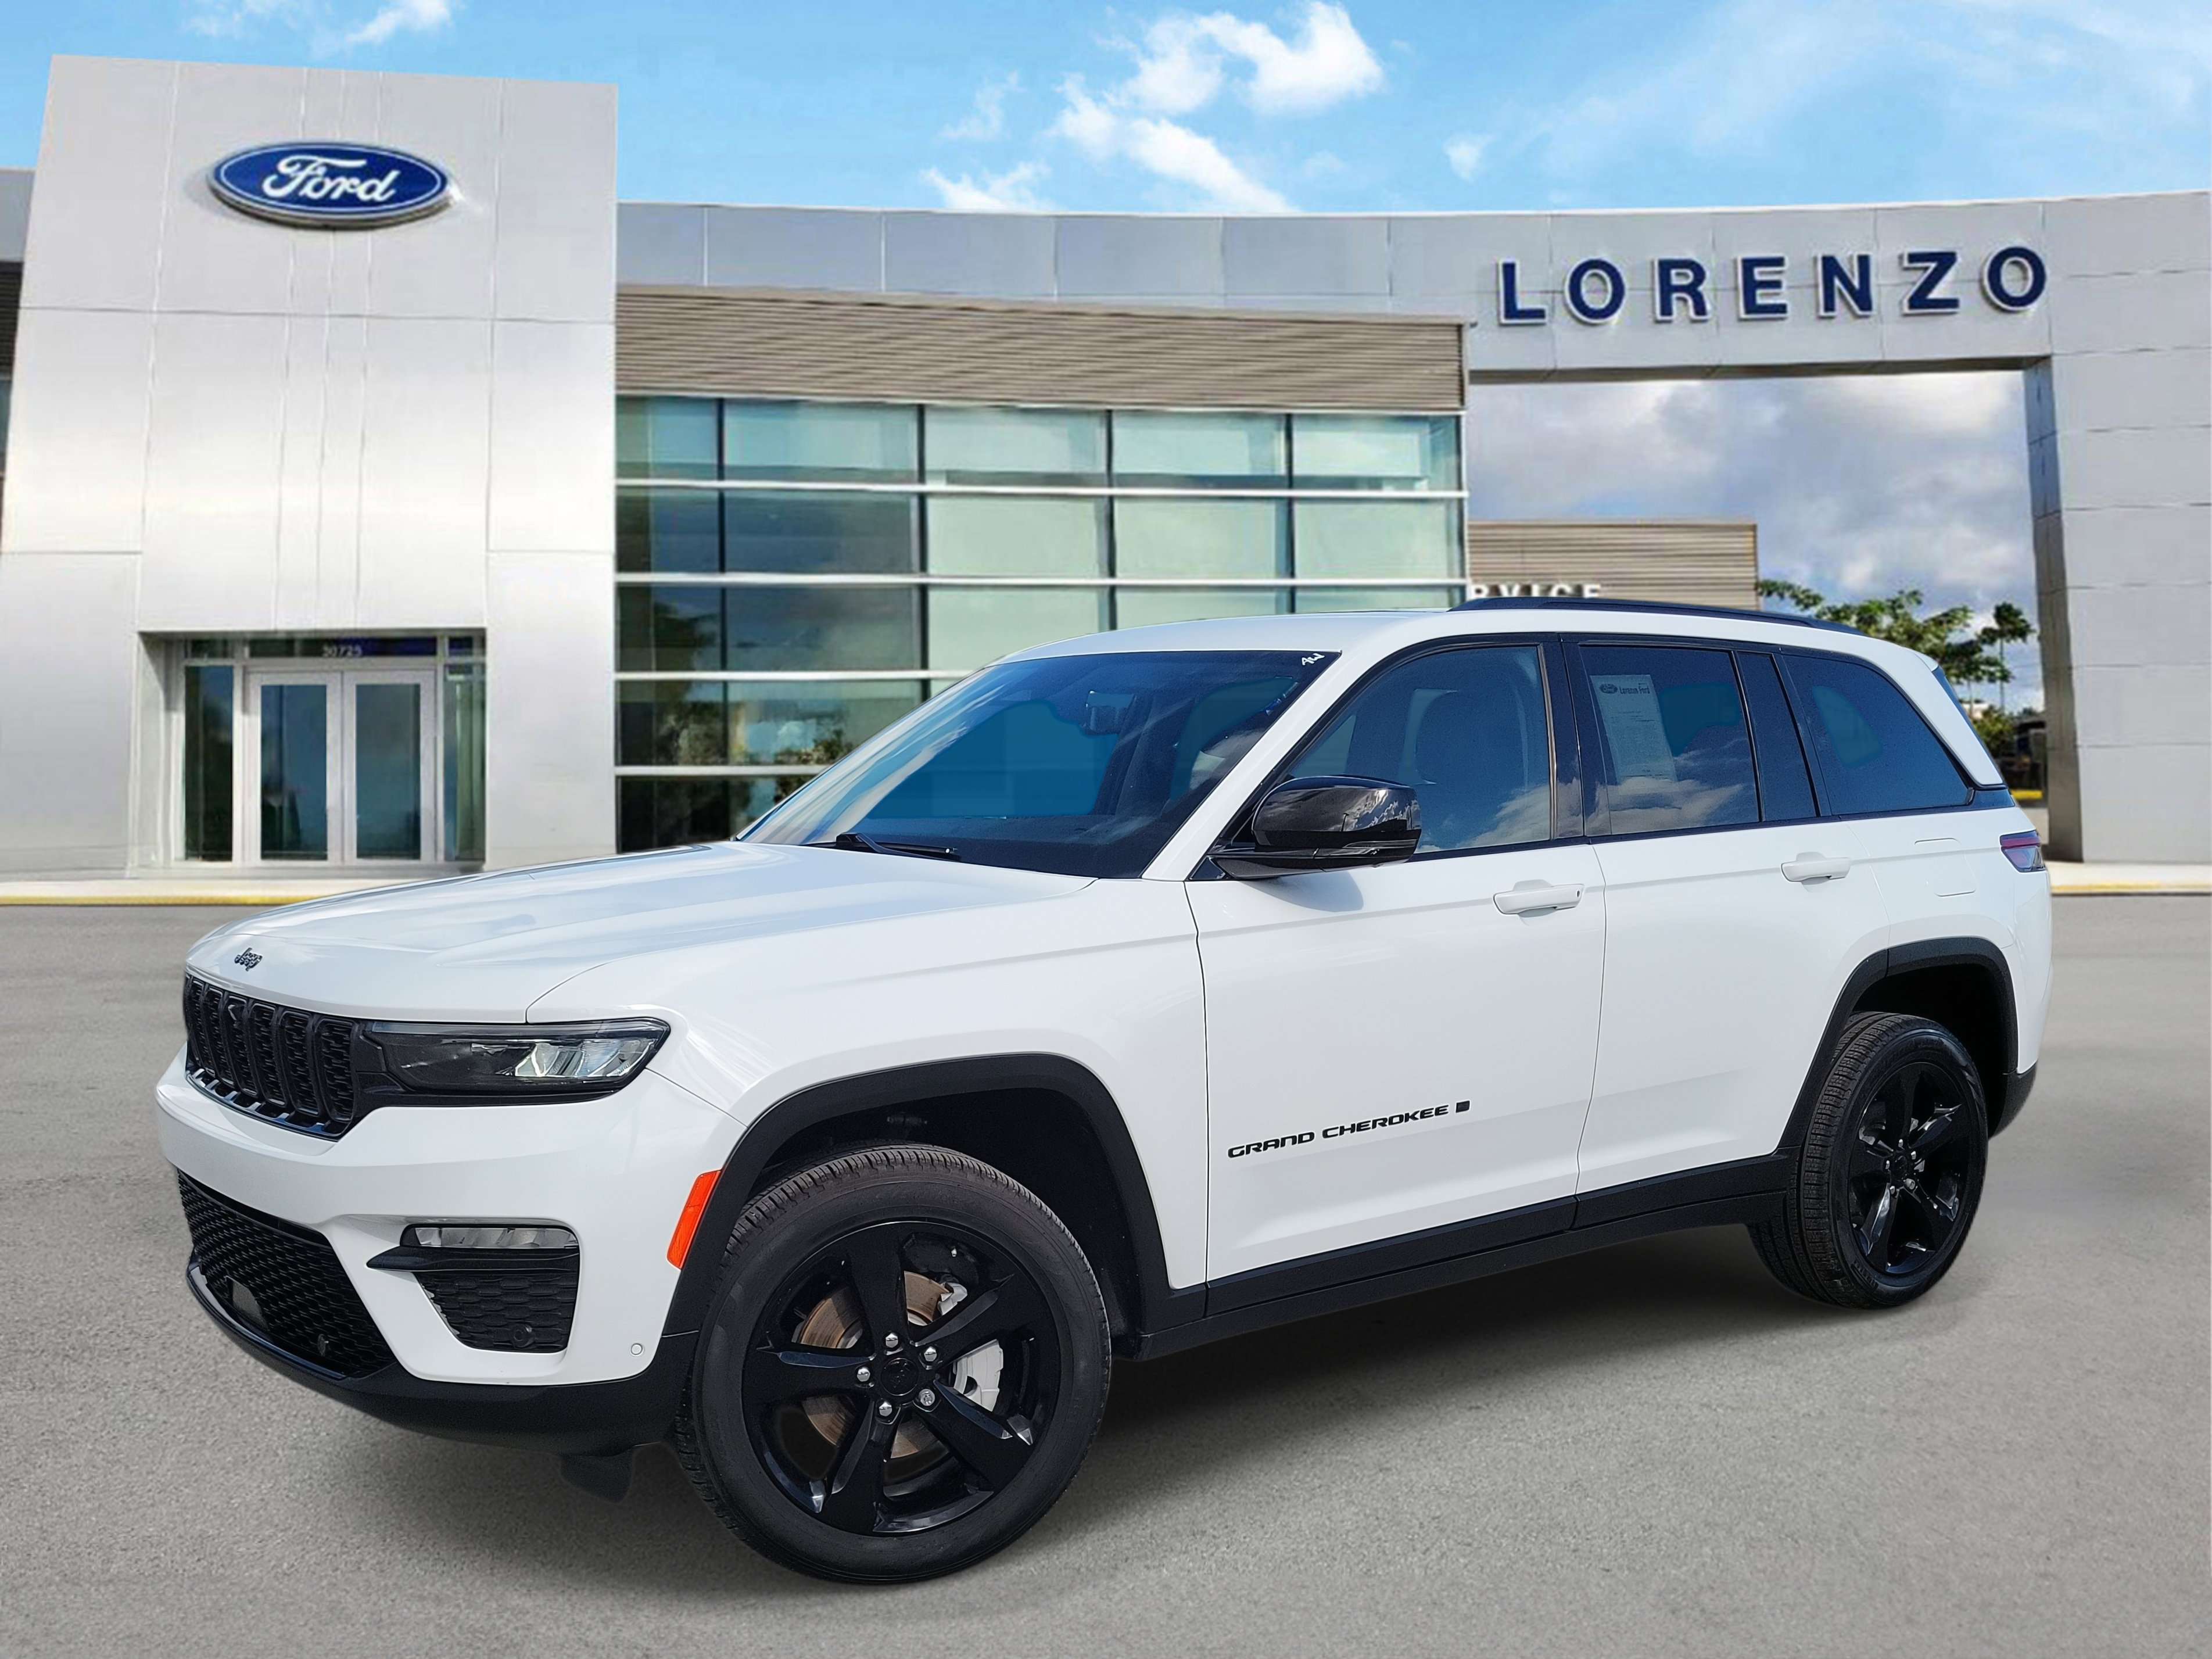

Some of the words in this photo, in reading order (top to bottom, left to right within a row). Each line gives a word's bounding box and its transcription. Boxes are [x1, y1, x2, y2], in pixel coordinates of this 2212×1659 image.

[262, 155, 400, 202] Ford
[1498, 246, 2047, 325] LORENZO
[234, 947, 263, 972] Jeep
[1228, 1131, 1315, 1158] GRAND
[1322, 1105, 1449, 1139] CHEROKEE
